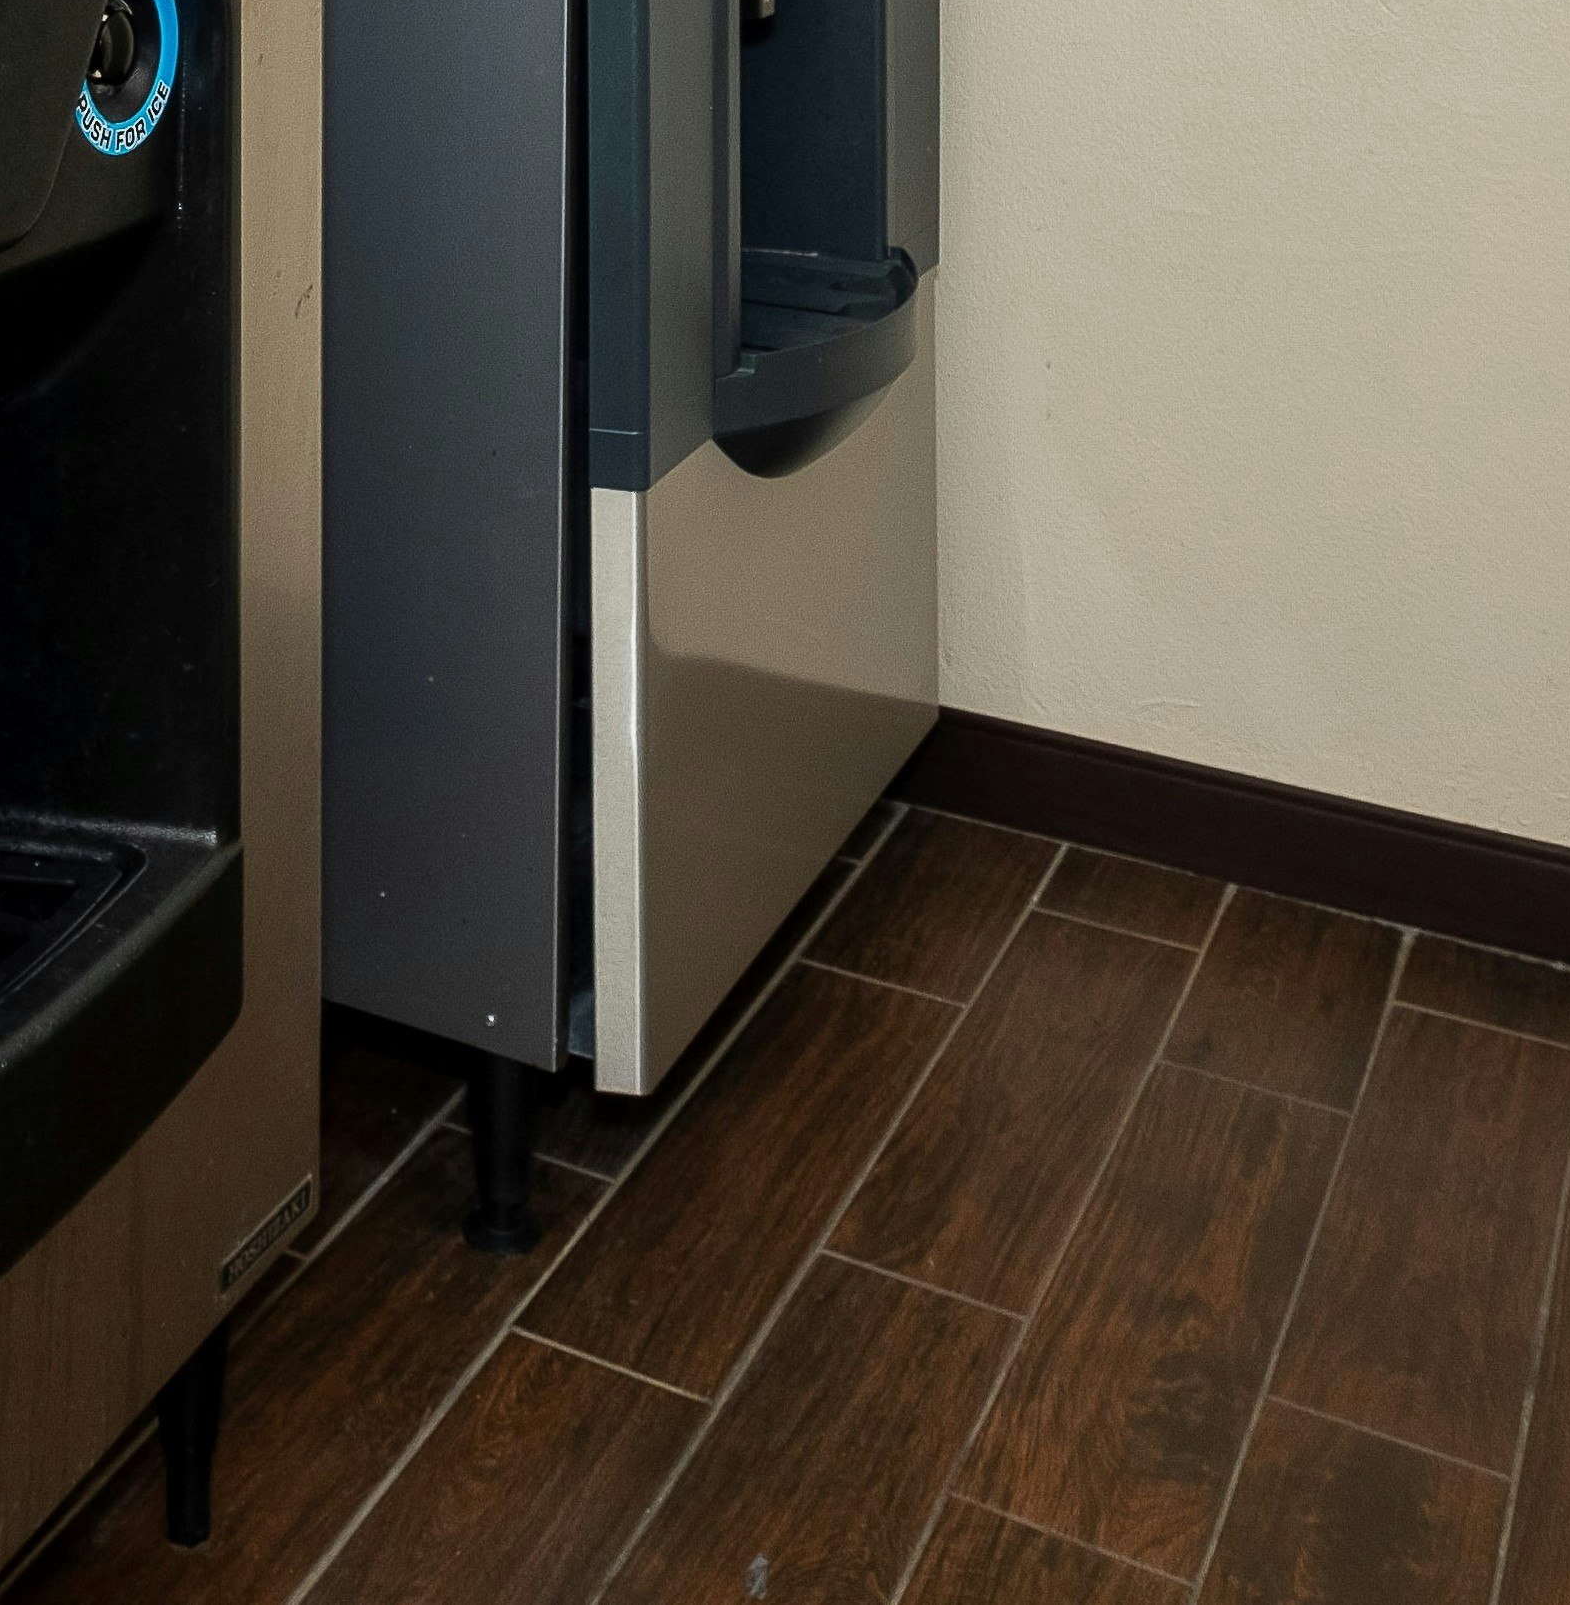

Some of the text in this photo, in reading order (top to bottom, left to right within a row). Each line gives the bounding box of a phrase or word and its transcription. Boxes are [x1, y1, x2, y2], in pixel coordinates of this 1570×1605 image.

[77, 80, 171, 152] PUSH FOR ICE
